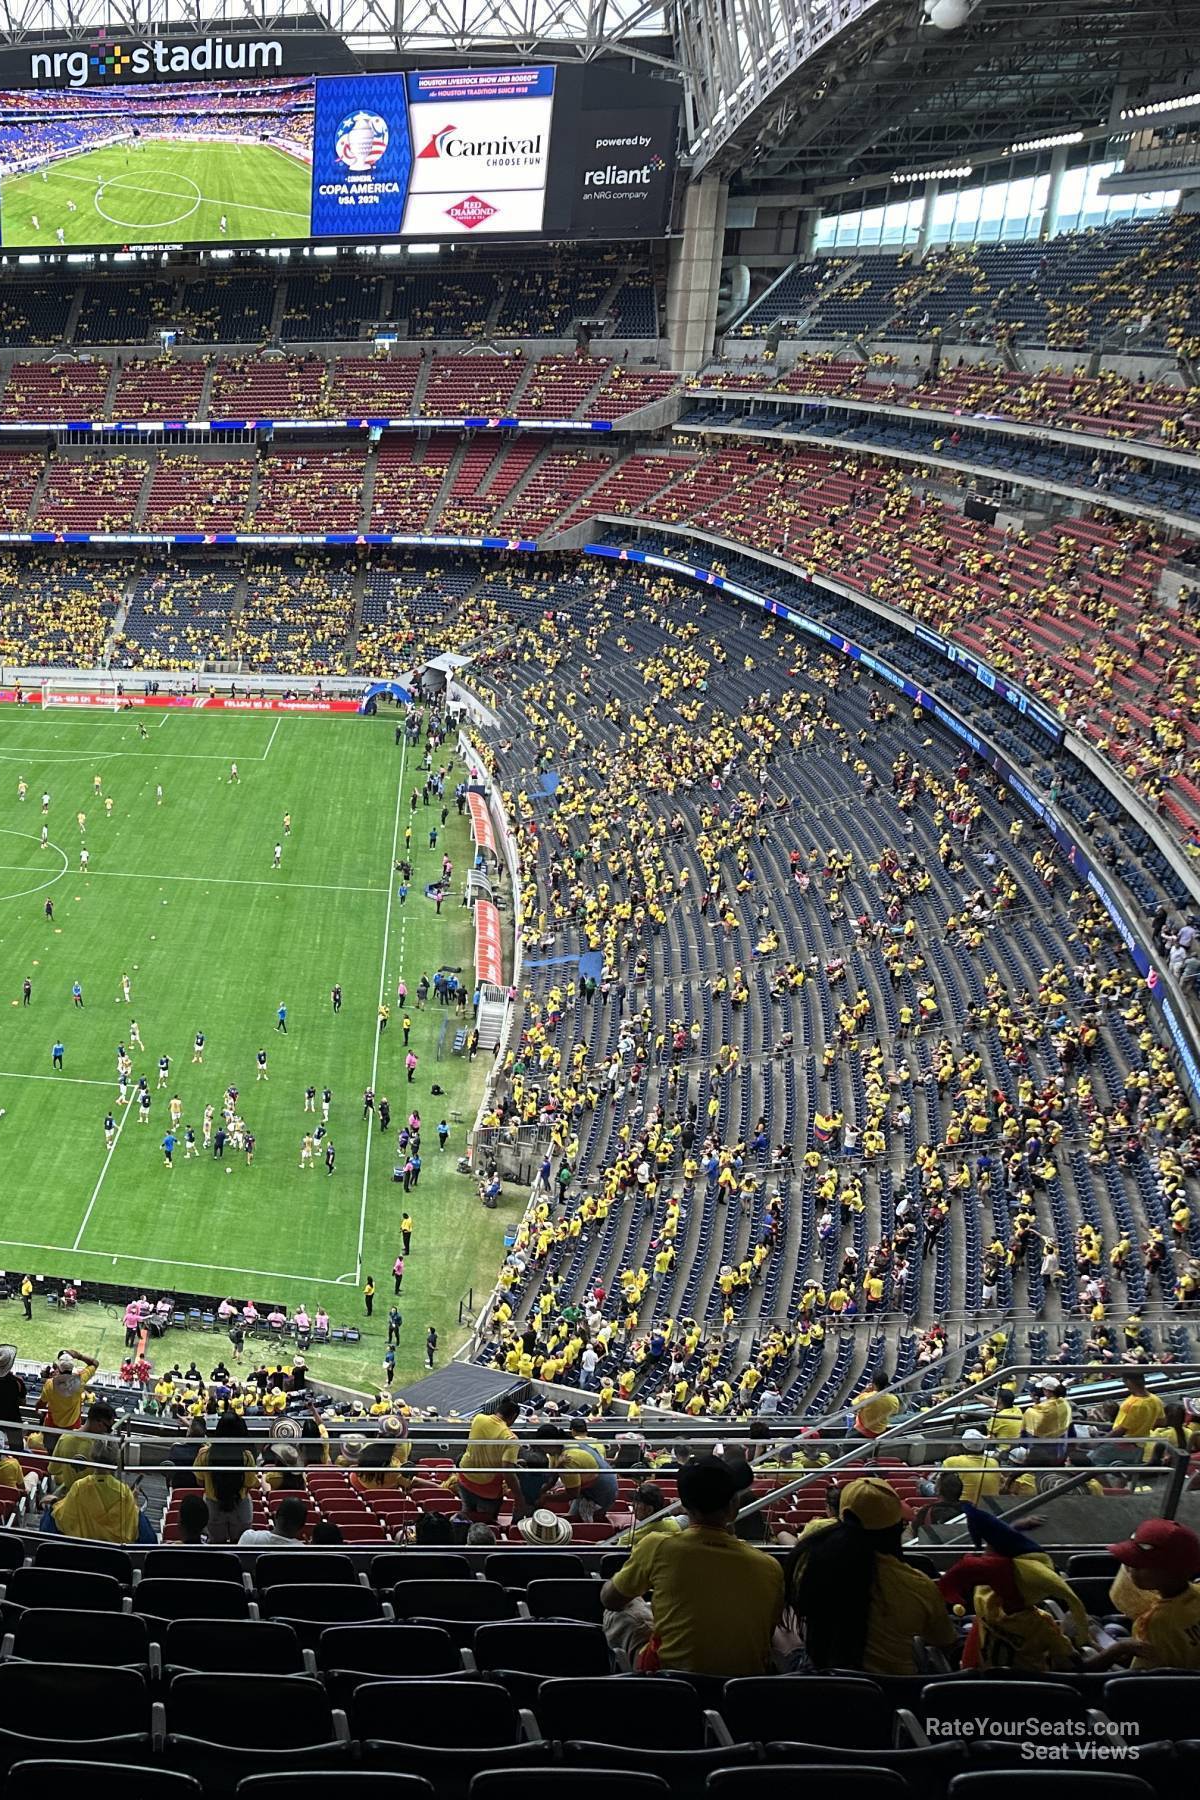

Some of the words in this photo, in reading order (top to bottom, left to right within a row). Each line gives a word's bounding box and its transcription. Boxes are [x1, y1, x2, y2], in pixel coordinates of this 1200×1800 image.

[31, 52, 88, 86] nrg
[132, 38, 282, 73] stadium
[446, 134, 540, 158] Carnival
[596, 136, 638, 148] powered
[639, 136, 652, 147] by
[486, 158, 520, 166] CHOOSE
[524, 157, 540, 166] FUN
[584, 166, 650, 186] reliant
[320, 184, 348, 195] COPA
[338, 196, 356, 205] USA
[582, 192, 592, 200] an
[594, 191, 612, 200] NRG
[612, 192, 648, 200] company
[450, 208, 494, 216] DIAMOND
